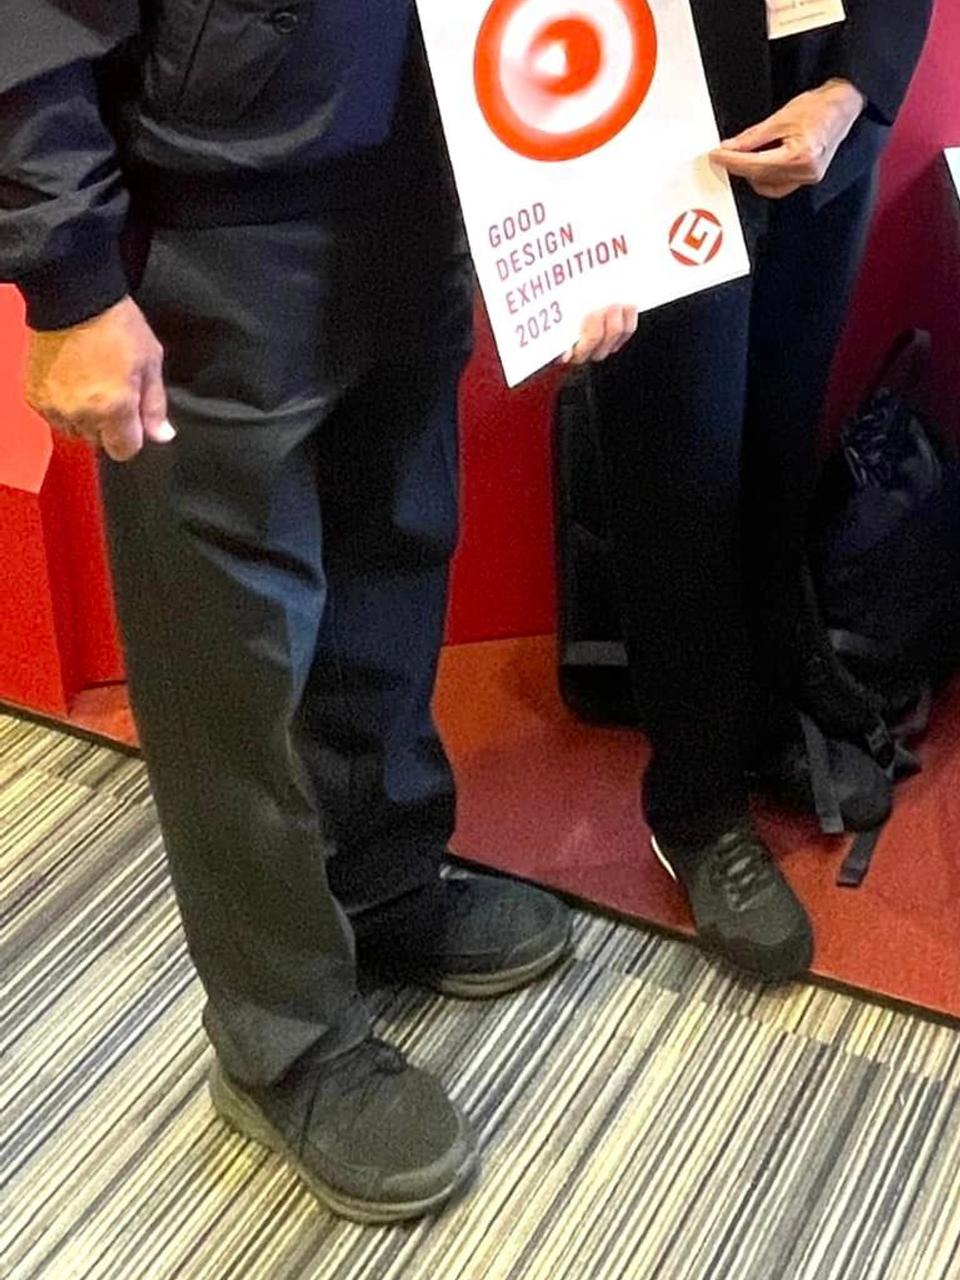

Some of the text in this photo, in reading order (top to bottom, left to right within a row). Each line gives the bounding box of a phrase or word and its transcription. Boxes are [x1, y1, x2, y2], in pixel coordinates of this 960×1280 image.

[488, 201, 546, 248] GOOD
[496, 222, 575, 281] DESIGN
[505, 234, 629, 315] EXHIBITION
[515, 301, 564, 348] 2023
